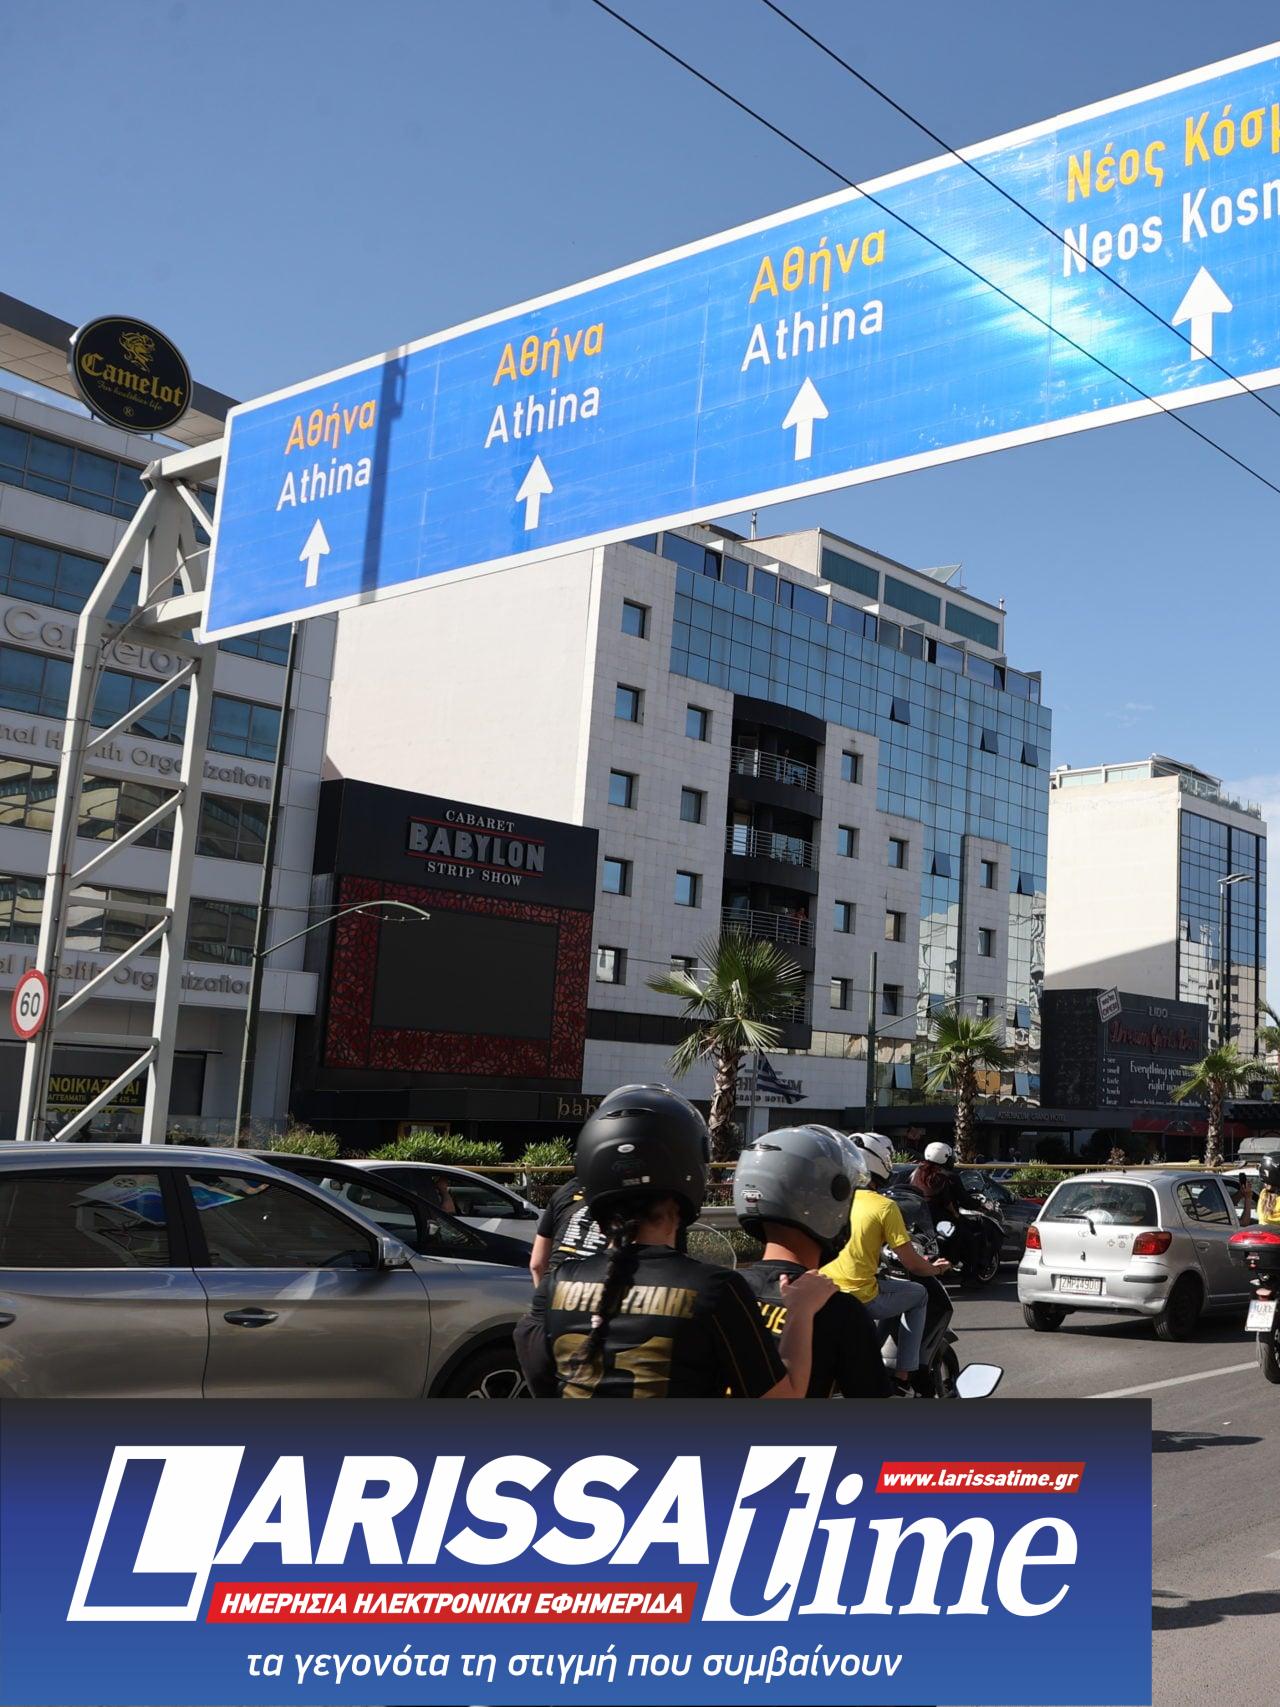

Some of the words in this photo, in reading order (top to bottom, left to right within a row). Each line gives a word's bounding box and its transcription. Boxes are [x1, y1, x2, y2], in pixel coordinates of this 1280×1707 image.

[1067, 140, 1166, 203] Νέος
[749, 229, 885, 304] Αθήνα
[1062, 216, 1163, 278] Neos
[492, 323, 604, 387] Αθήνα
[740, 300, 883, 372] Athina
[81, 352, 183, 407] Camelot
[284, 400, 376, 455] Αθήνα
[484, 386, 600, 449] Athina
[275, 457, 372, 512] Athina
[408, 822, 545, 872] BABYLON
[446, 810, 515, 833] CABARET
[427, 861, 475, 878] STRIP
[481, 870, 522, 886] SHOW
[20, 992, 41, 1017] 60
[1130, 1060, 1168, 1080] Everything
